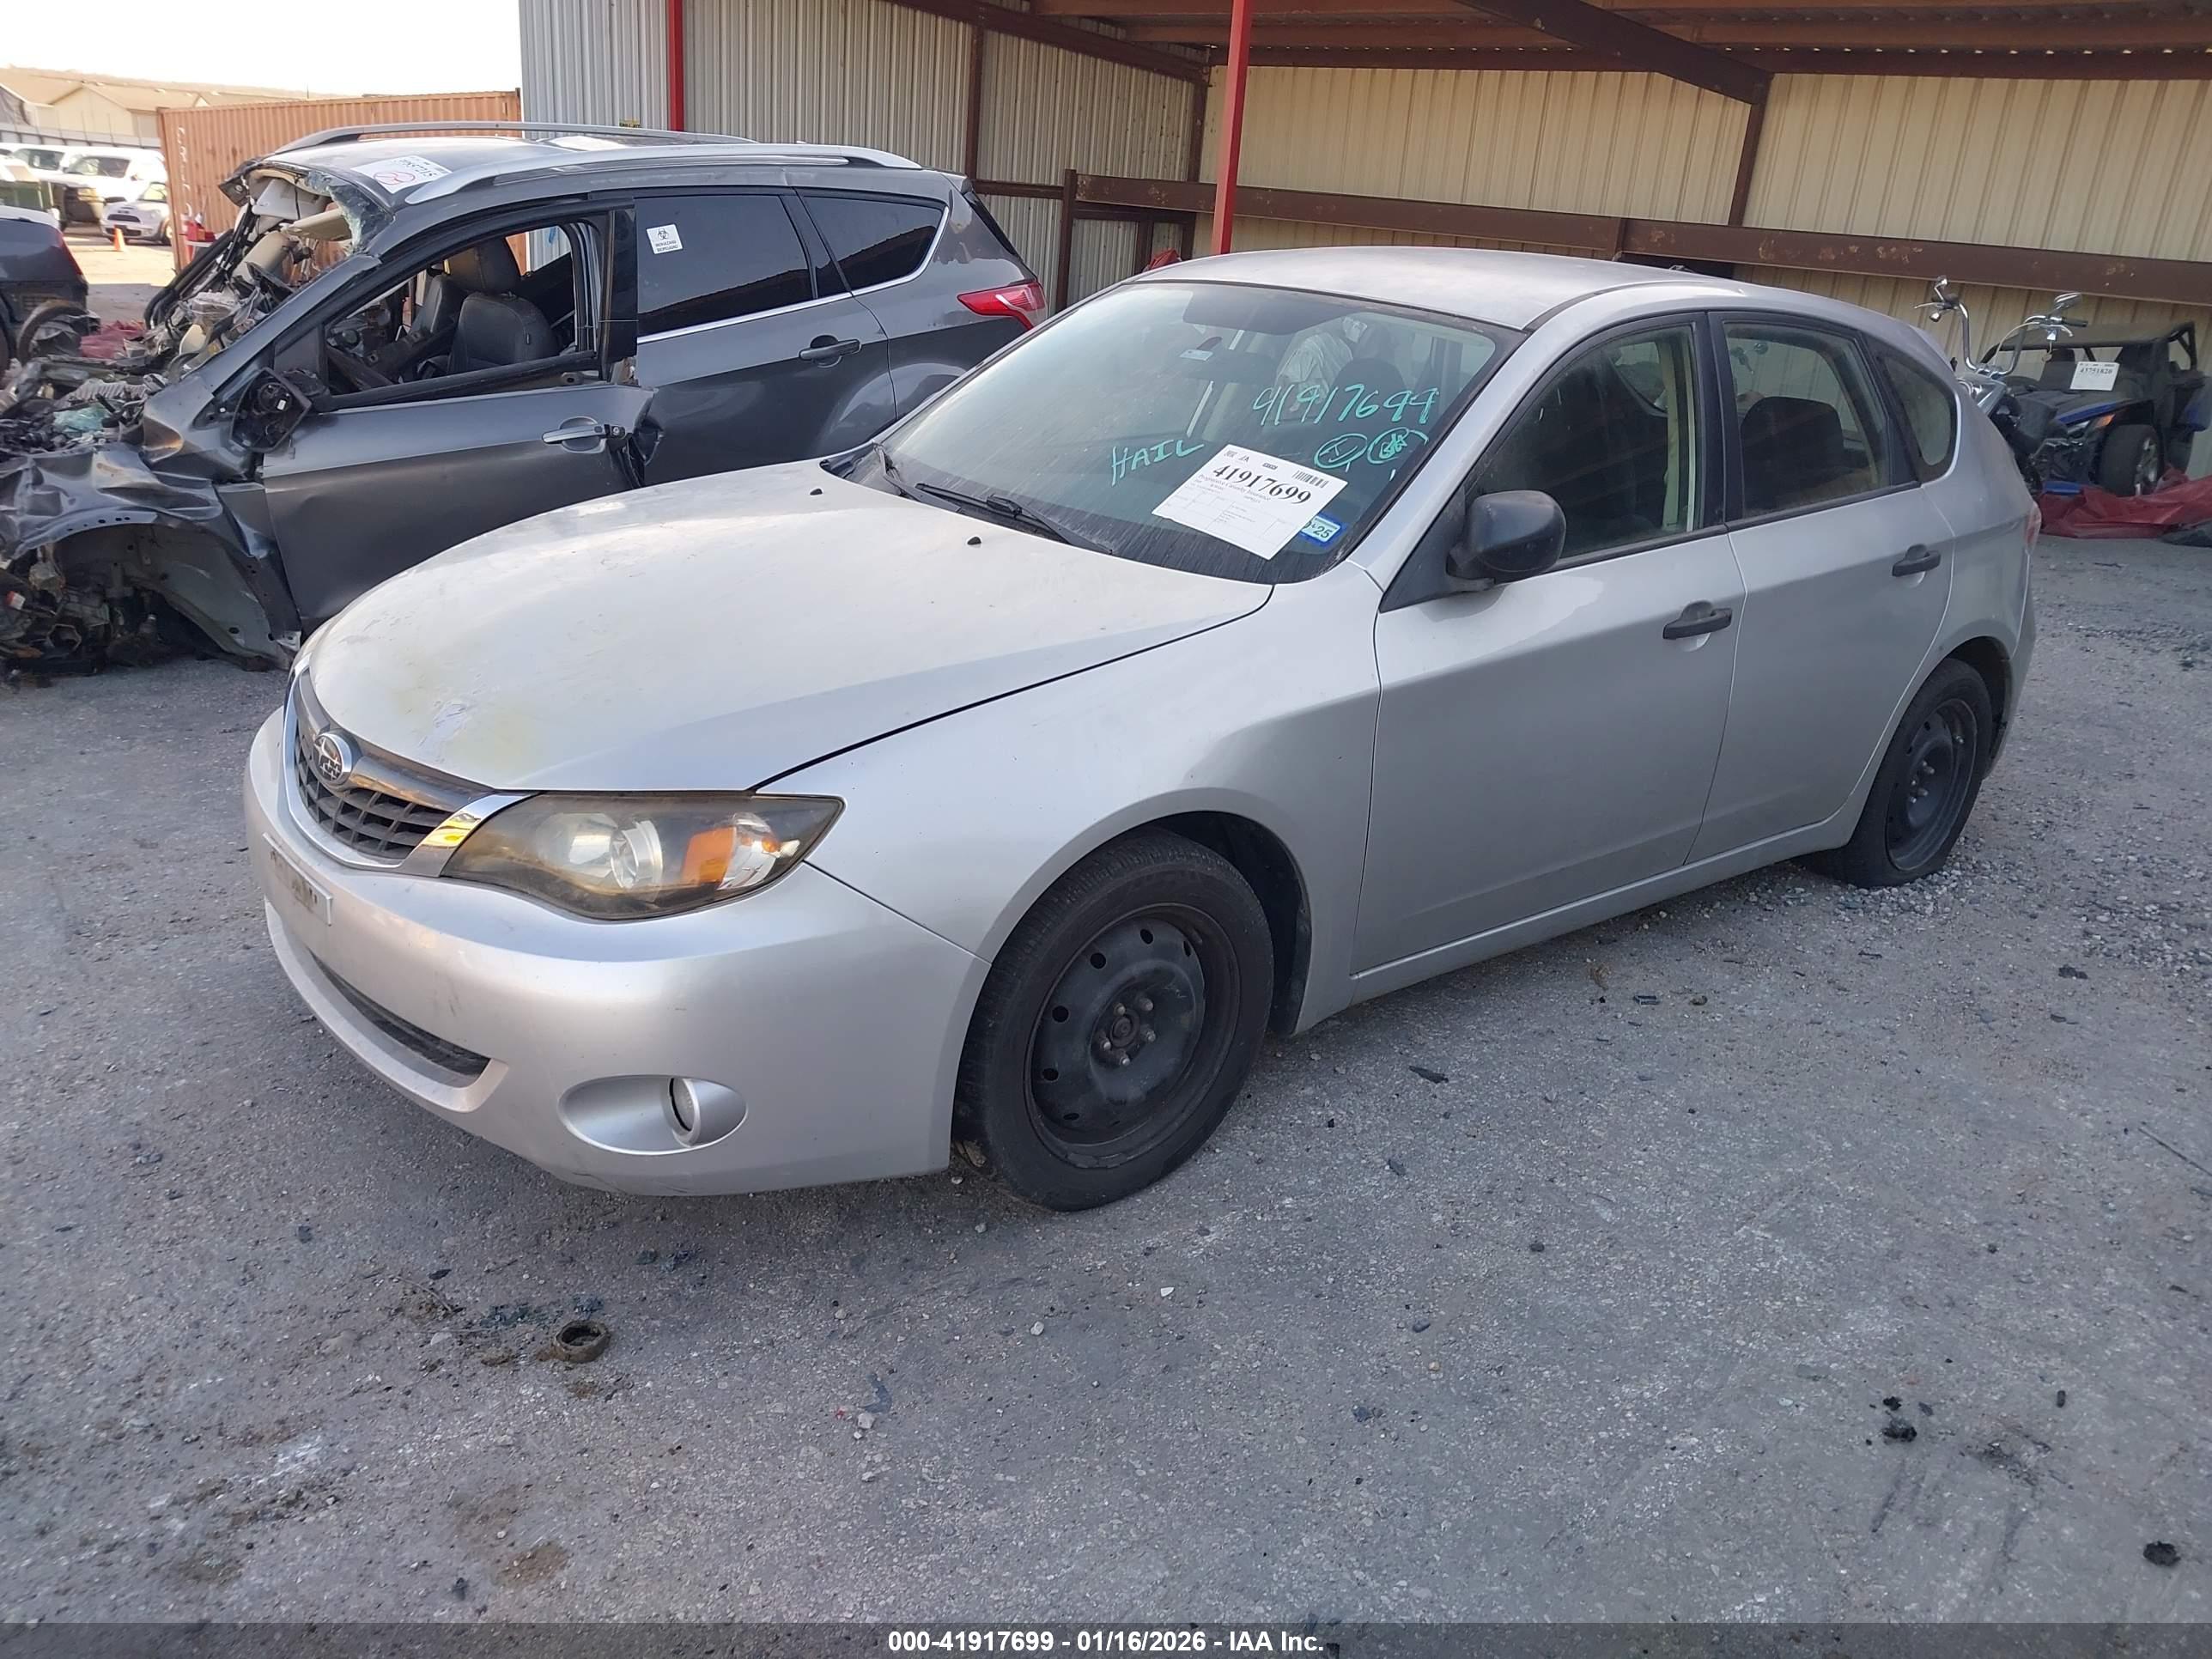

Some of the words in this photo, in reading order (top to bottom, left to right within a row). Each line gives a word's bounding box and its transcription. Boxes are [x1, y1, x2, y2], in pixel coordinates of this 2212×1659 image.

[1111, 439, 1205, 487] HAIL
[1212, 465, 1312, 505] 41917699
[1313, 526, 1333, 538] 25
